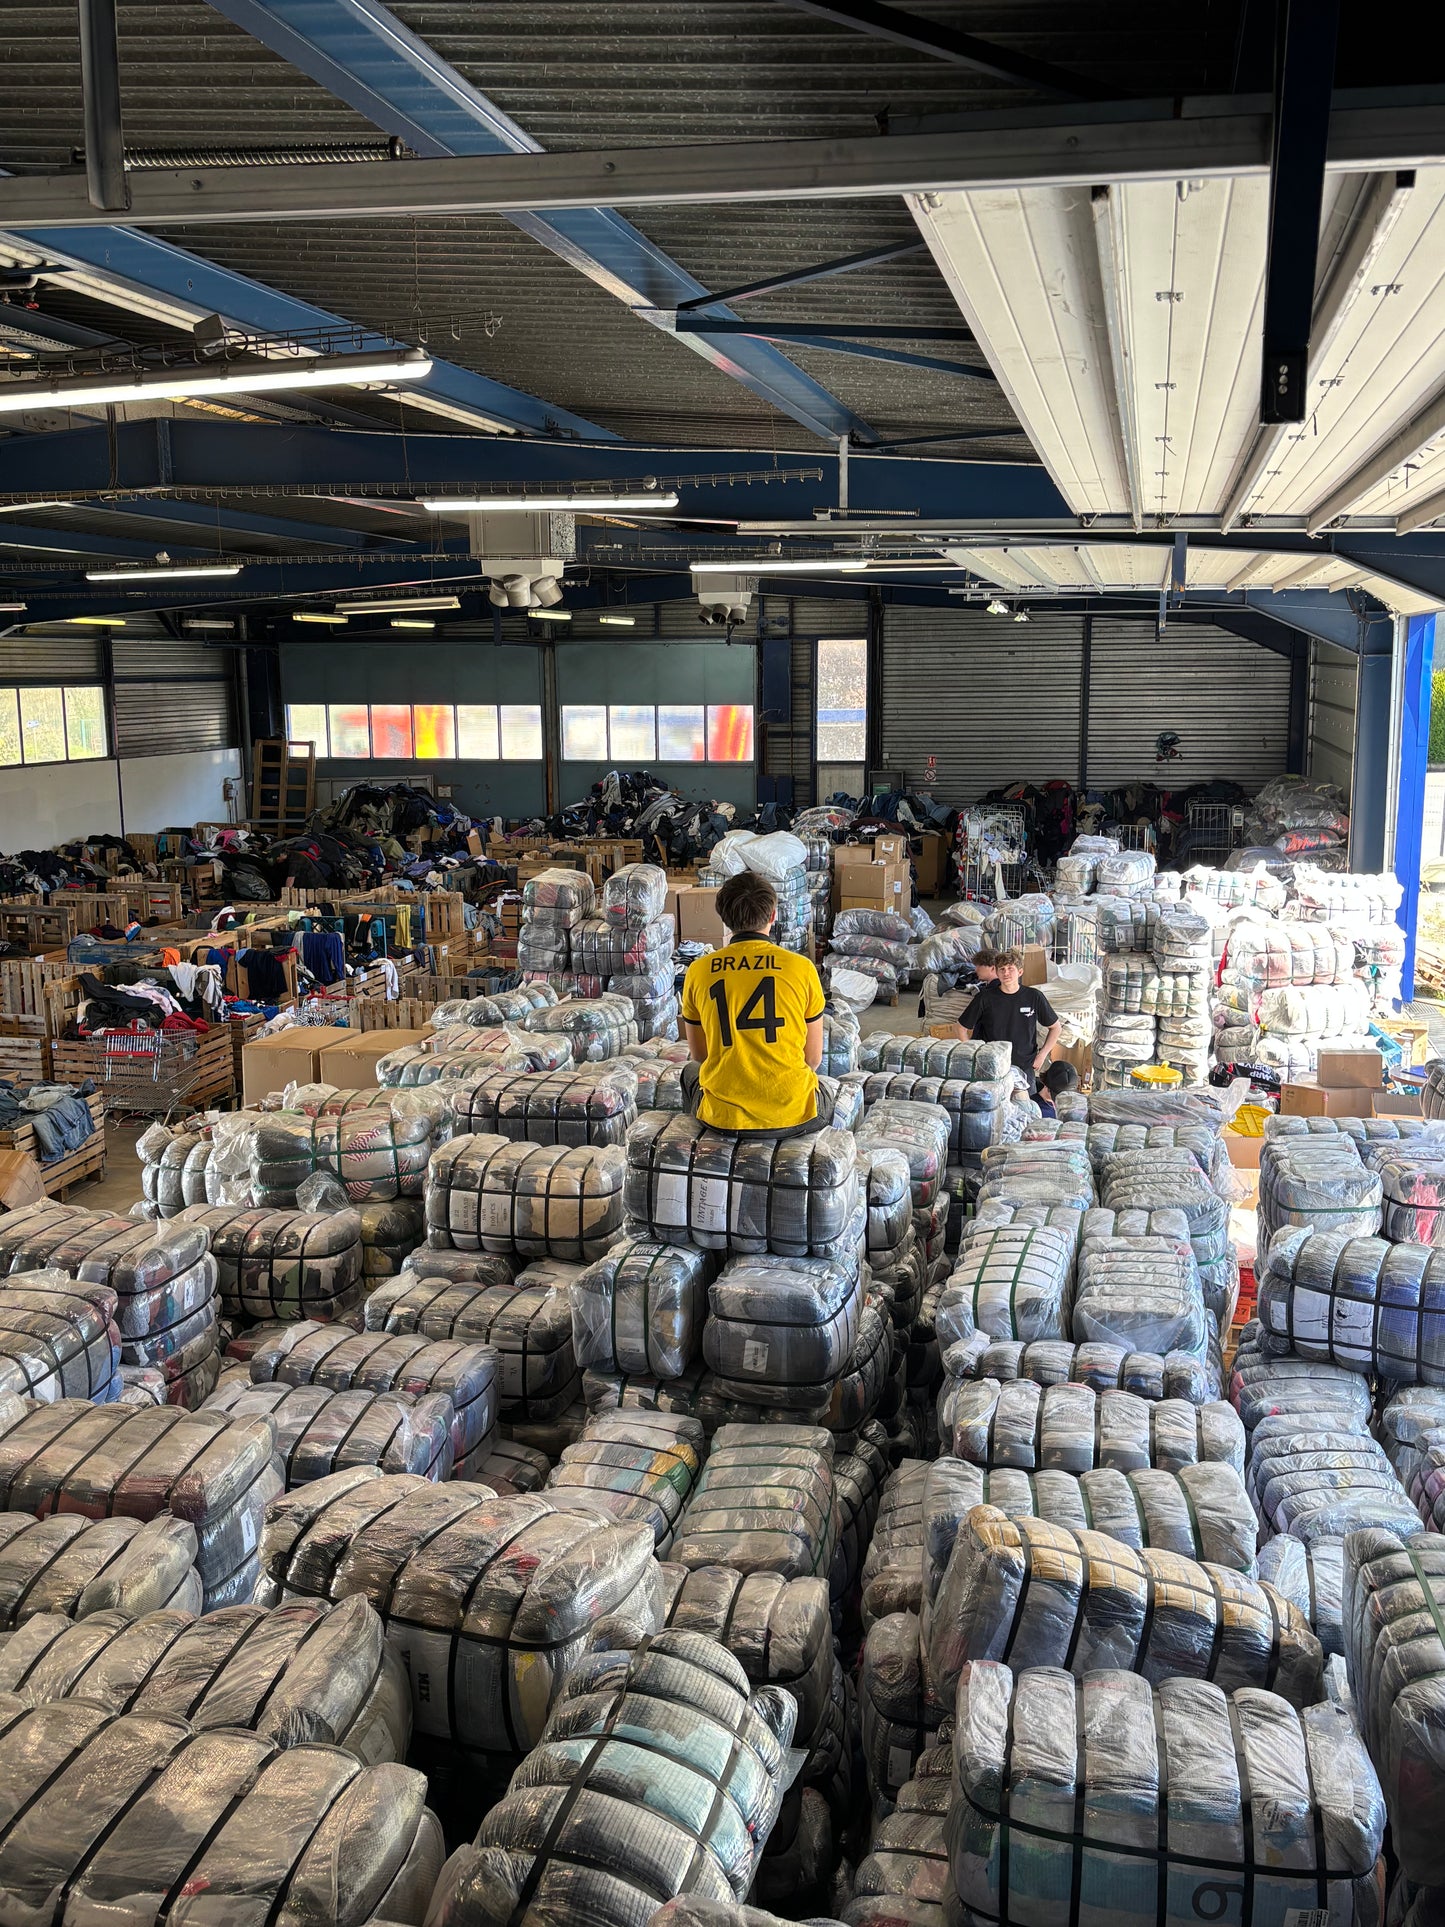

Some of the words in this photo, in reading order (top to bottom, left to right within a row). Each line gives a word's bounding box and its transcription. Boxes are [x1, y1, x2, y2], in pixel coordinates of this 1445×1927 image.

[711, 955, 782, 973] BRAZIL
[709, 976, 785, 1047] 14
[697, 1184, 708, 1224] VINTAGE
